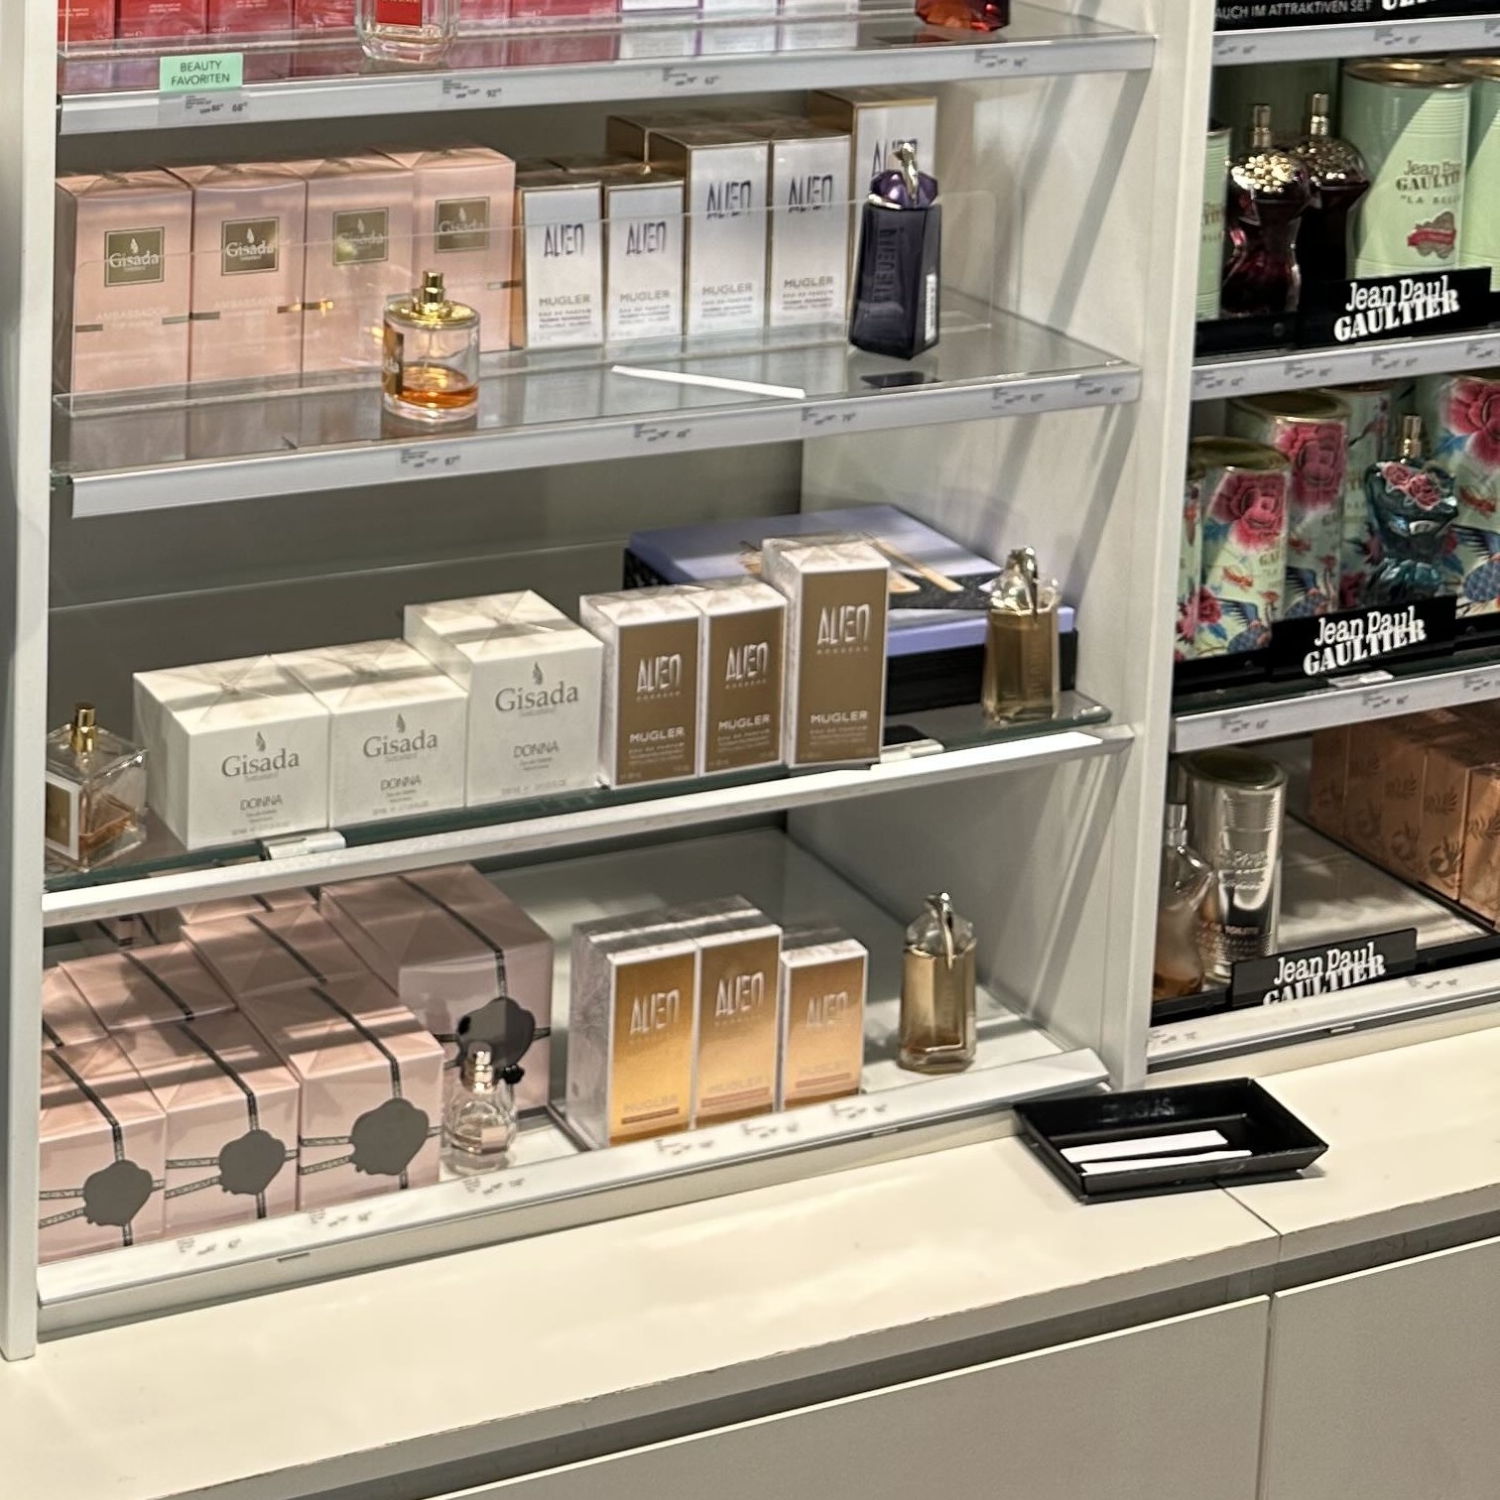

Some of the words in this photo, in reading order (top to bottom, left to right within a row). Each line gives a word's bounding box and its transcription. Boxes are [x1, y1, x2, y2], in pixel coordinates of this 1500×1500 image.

[1215, 3, 1249, 20] AUCH
[1251, 2, 1267, 17] IM
[1268, 0, 1349, 17] ATTRAKTIVEN
[170, 72, 231, 87] FAVORITEN
[179, 59, 222, 73] BEAUTY
[1403, 159, 1440, 176] Jean
[706, 179, 752, 220] ALIEN
[788, 174, 834, 214] ALIEN
[225, 240, 274, 258] Gisada
[544, 222, 586, 258] ALIEN
[626, 220, 668, 256] ALIEN
[109, 251, 160, 268] Gisada
[619, 289, 671, 303] MUGLER
[701, 282, 754, 297] MUGLER
[783, 275, 835, 290] MUGLER
[1345, 281, 1398, 312] Jean
[1399, 274, 1449, 303] Paul
[539, 294, 591, 307] MUGLER
[1333, 288, 1461, 343] GAULTIER
[816, 602, 870, 646] ALIEN
[1314, 615, 1365, 647] Jean
[1366, 604, 1417, 638] Paul
[725, 641, 770, 684] ALIEN
[1302, 618, 1428, 676] GAULTIER
[636, 652, 683, 695] ALIEN
[494, 680, 580, 714] Gisada
[717, 713, 772, 732] MUGLER
[810, 709, 869, 726] MUGLER
[362, 728, 439, 759] Gisada
[512, 739, 560, 760] DONNA
[628, 726, 686, 744] MUGLER
[220, 748, 301, 779] Gisada
[380, 774, 423, 792] DONNA
[240, 793, 283, 811] DONNA
[1273, 955, 1323, 986] Jean
[1326, 941, 1377, 971] Paul
[714, 970, 766, 1018] ALIEN
[1263, 953, 1387, 1006] GAULTIER
[629, 988, 681, 1037] ALIEN
[805, 990, 850, 1030] ALIEN
